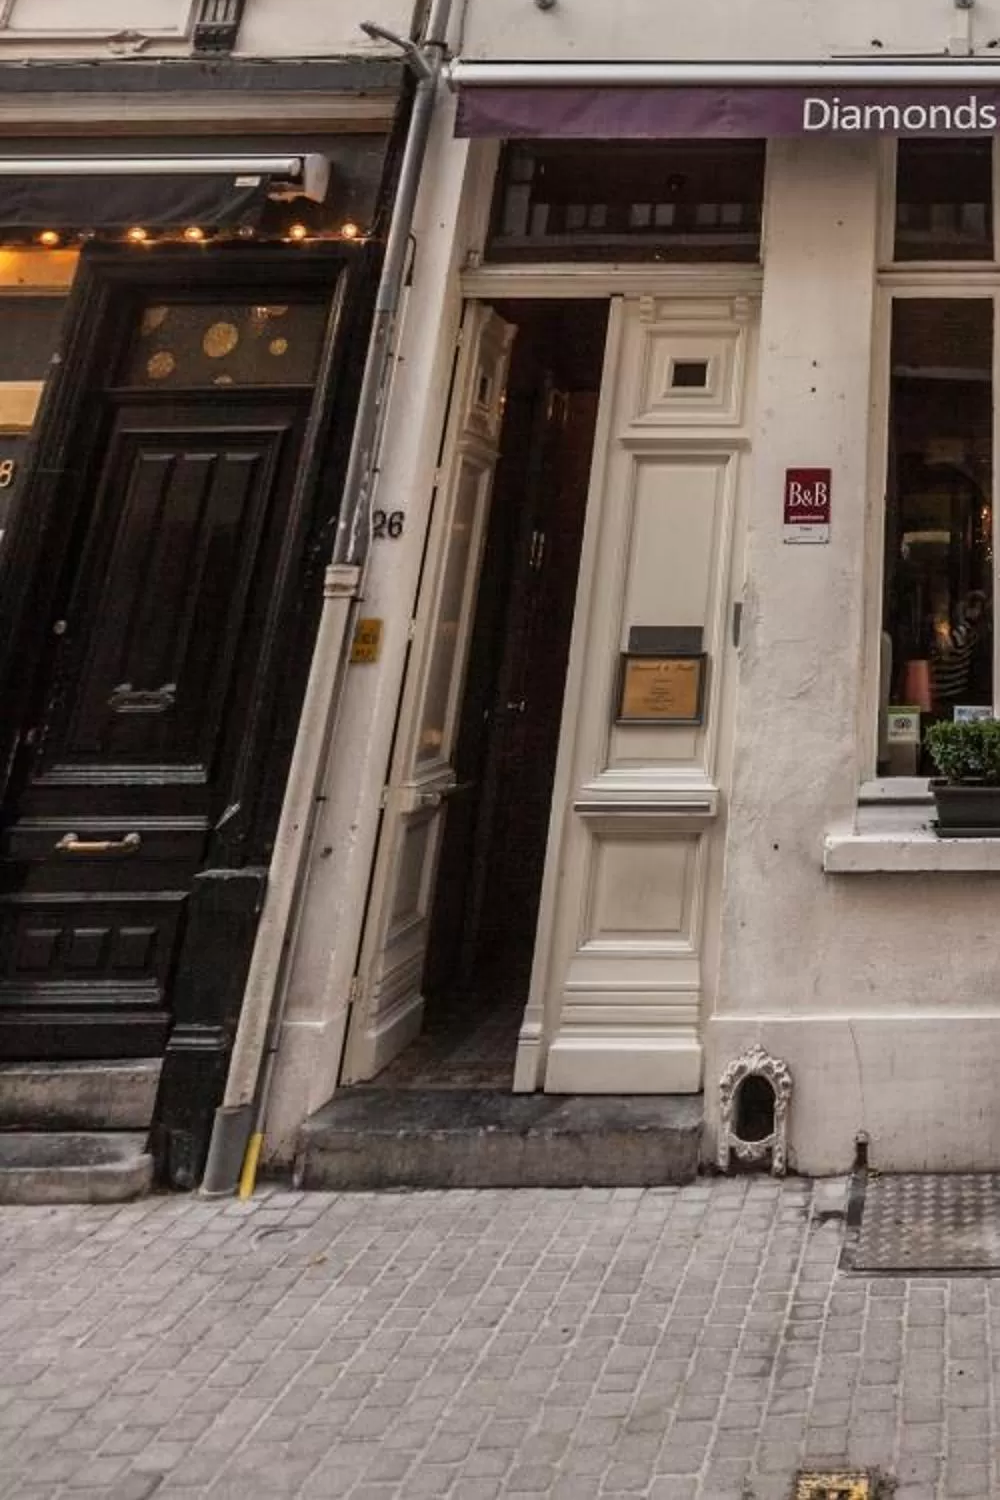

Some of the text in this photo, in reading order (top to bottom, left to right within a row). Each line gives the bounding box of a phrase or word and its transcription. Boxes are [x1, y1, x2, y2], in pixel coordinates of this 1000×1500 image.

[803, 95, 997, 130] Diamonds
[789, 481, 828, 507] B&B
[373, 509, 404, 539] 26
